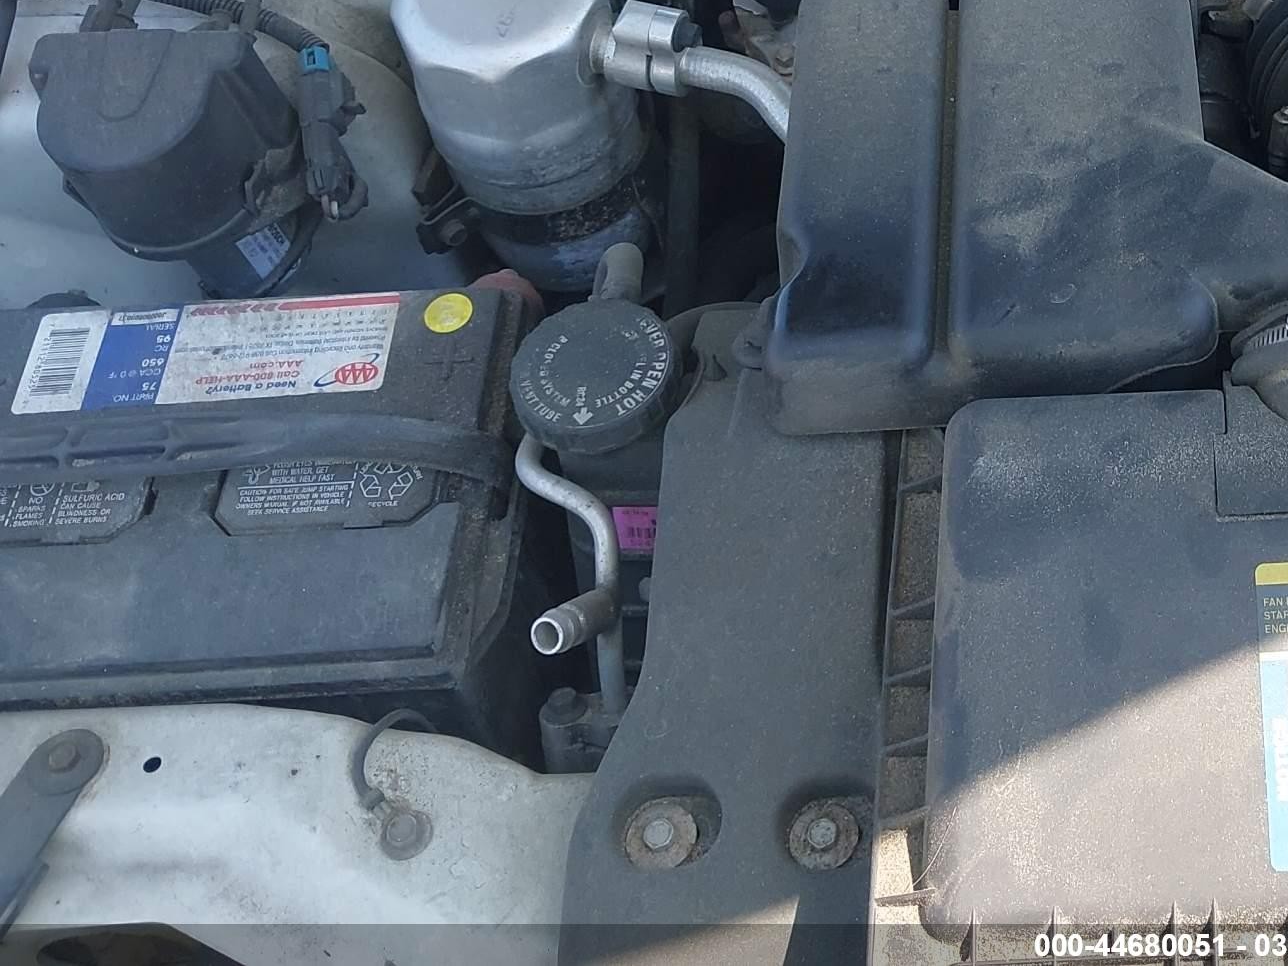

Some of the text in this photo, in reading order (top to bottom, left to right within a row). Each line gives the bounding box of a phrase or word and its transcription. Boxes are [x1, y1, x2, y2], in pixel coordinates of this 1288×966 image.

[156, 334, 171, 344] 95
[154, 344, 168, 352] RC
[142, 358, 164, 367] 650
[250, 360, 304, 369] AAA.com
[140, 368, 161, 377] CCA
[278, 370, 300, 378] Call
[338, 364, 376, 384] AAA
[142, 382, 157, 391] 75
[205, 382, 251, 395] Battery?
[266, 380, 296, 390] Need
[132, 392, 154, 402] PART
[594, 381, 635, 410] BOTTLE
[616, 387, 646, 417] HOT
[534, 400, 563, 424] TUBE
[316, 466, 330, 474] GET
[28, 496, 44, 504] NO
[63, 492, 124, 503] SULFURIC ACID
[58, 509, 98, 517] BLINDNESS
[1263, 597, 1282, 606] FAN
